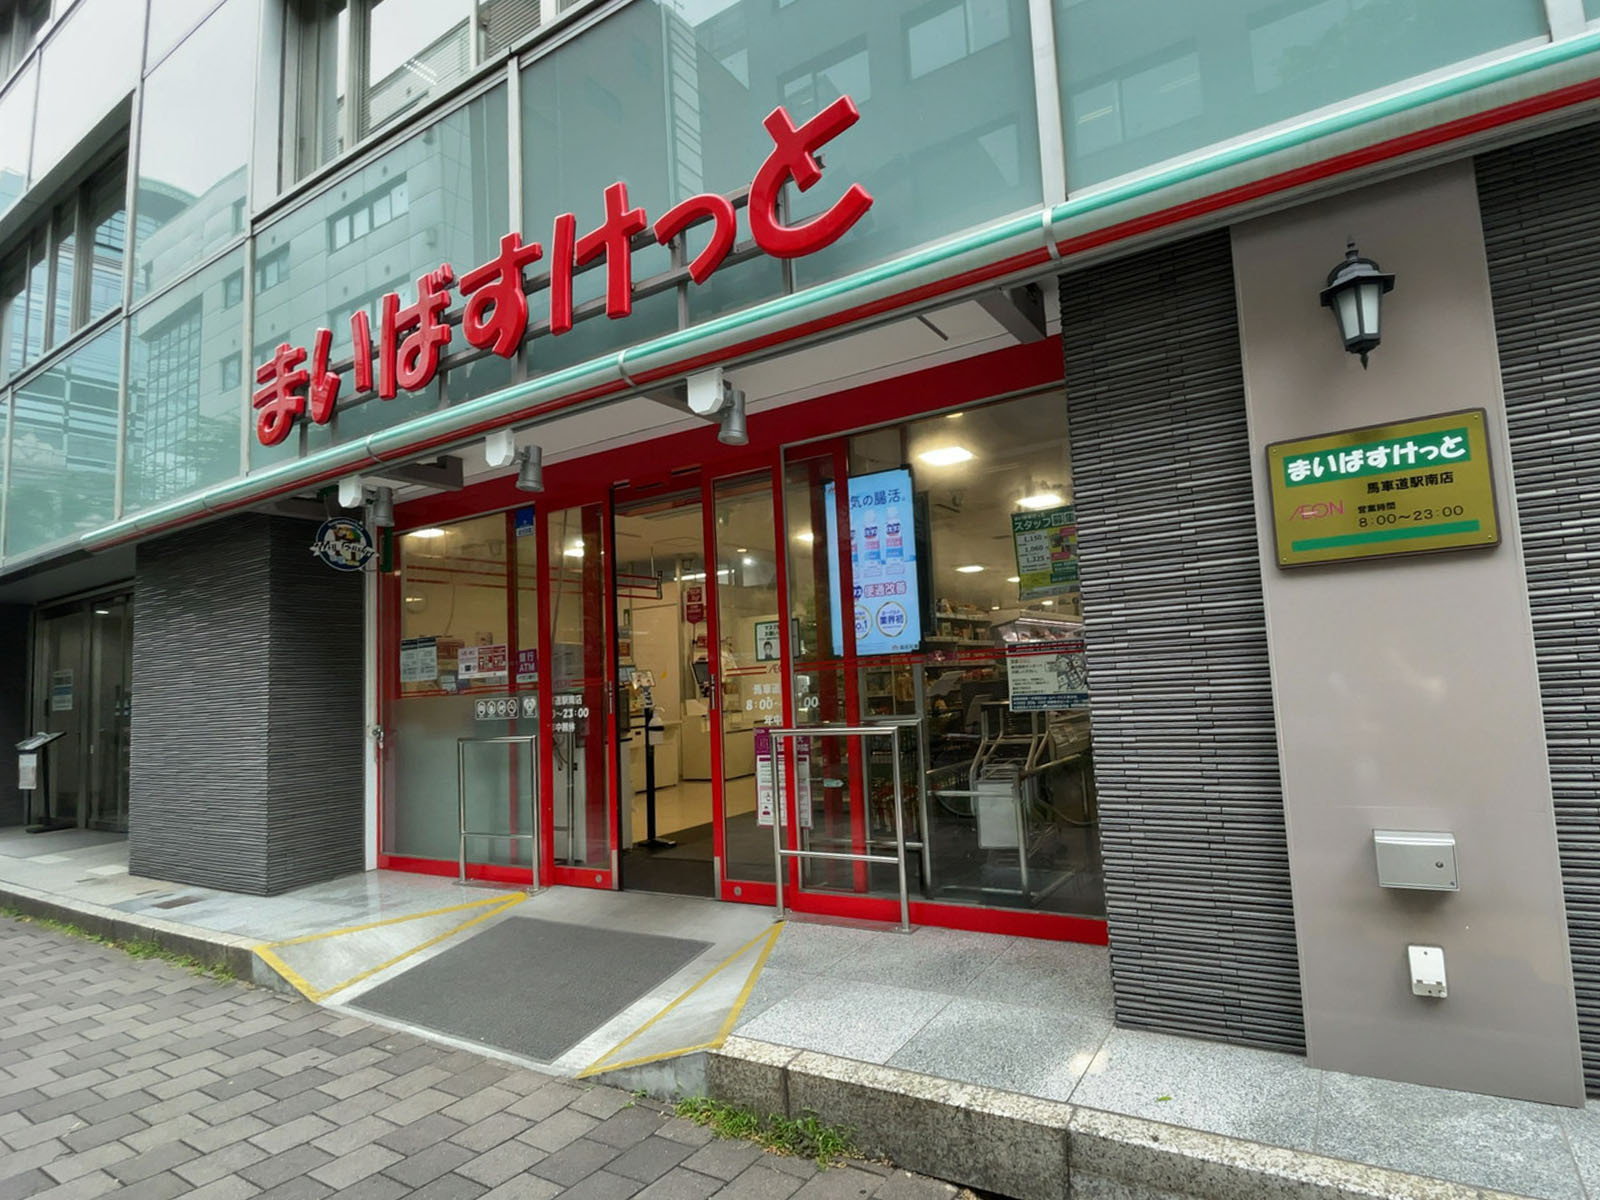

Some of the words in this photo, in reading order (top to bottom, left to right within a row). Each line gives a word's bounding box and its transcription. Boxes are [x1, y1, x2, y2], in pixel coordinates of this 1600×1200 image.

[253, 95, 874, 447] まいばすけっと
[1287, 436, 1466, 482] まいばすけっと
[1367, 471, 1454, 494] 馬車道駅南店
[1357, 502, 1396, 513] 営業時間
[518, 663, 536, 673] ATM
